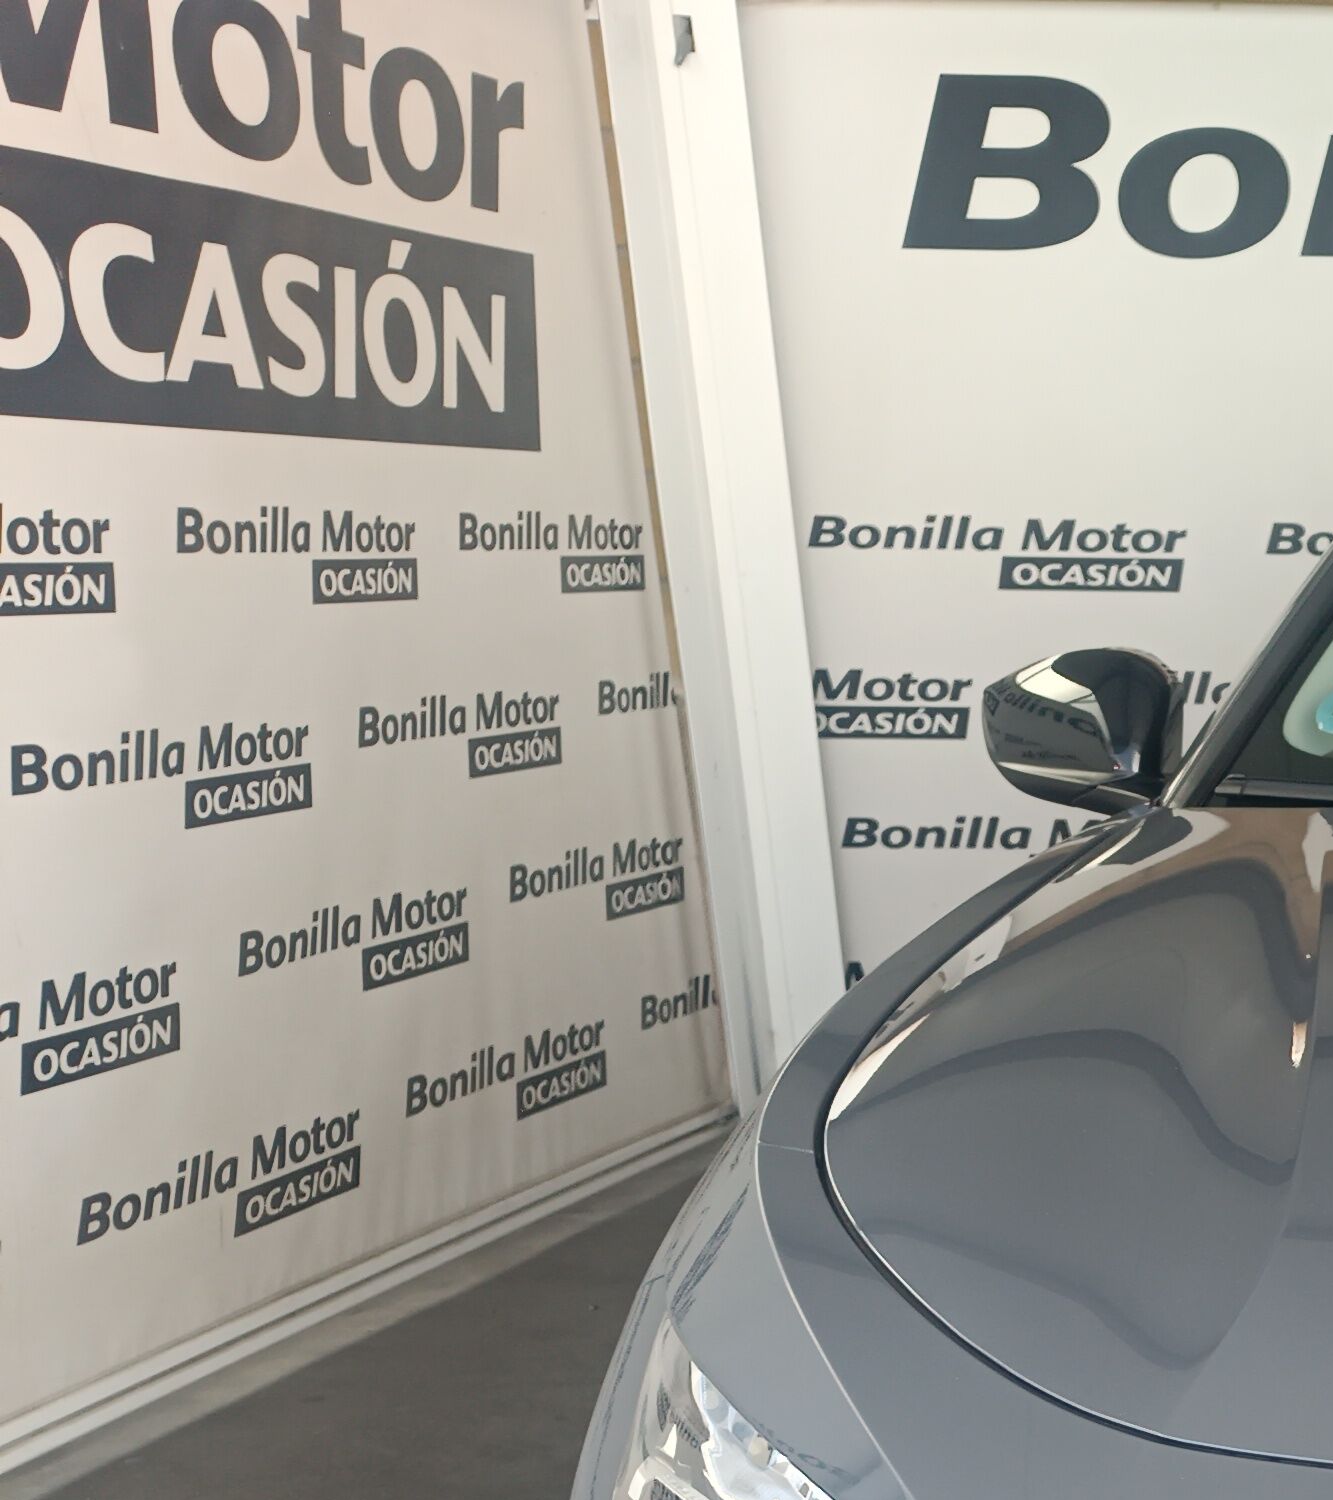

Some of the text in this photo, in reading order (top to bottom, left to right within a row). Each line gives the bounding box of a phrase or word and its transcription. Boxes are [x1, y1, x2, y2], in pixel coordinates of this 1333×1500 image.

[0, 508, 110, 556] otor
[177, 506, 416, 554] Bonilla Motor
[458, 511, 643, 551] Bonilla Motor
[807, 515, 1187, 554] Bonilla Motor
[319, 561, 413, 597] OCASIÓN
[566, 556, 641, 588] OCASIÓN
[1012, 560, 1174, 588] OCASIÓN
[597, 671, 679, 717] Bonill
[812, 668, 973, 703] Motor
[358, 691, 560, 748] Bonilla Motor
[11, 722, 309, 797] Bonilla Motor
[475, 733, 558, 771] OCASIÓN
[194, 770, 306, 819] OCASIÓN
[841, 816, 1032, 850] Bonilla
[509, 836, 684, 903] Bonilla Motor
[611, 872, 682, 915] OCASIÓN
[239, 887, 468, 977] Bonilla Motor
[369, 926, 465, 983] OCASIÓN
[39, 961, 177, 1031] Motor
[640, 974, 718, 1032] Bonill
[33, 1014, 172, 1083] OCASIÓN
[405, 1019, 605, 1118] Bonilla Motor
[521, 1056, 603, 1112] OCASIÓN
[77, 1109, 360, 1246] Bonilla Motor
[245, 1152, 354, 1225] OCASIÓN
